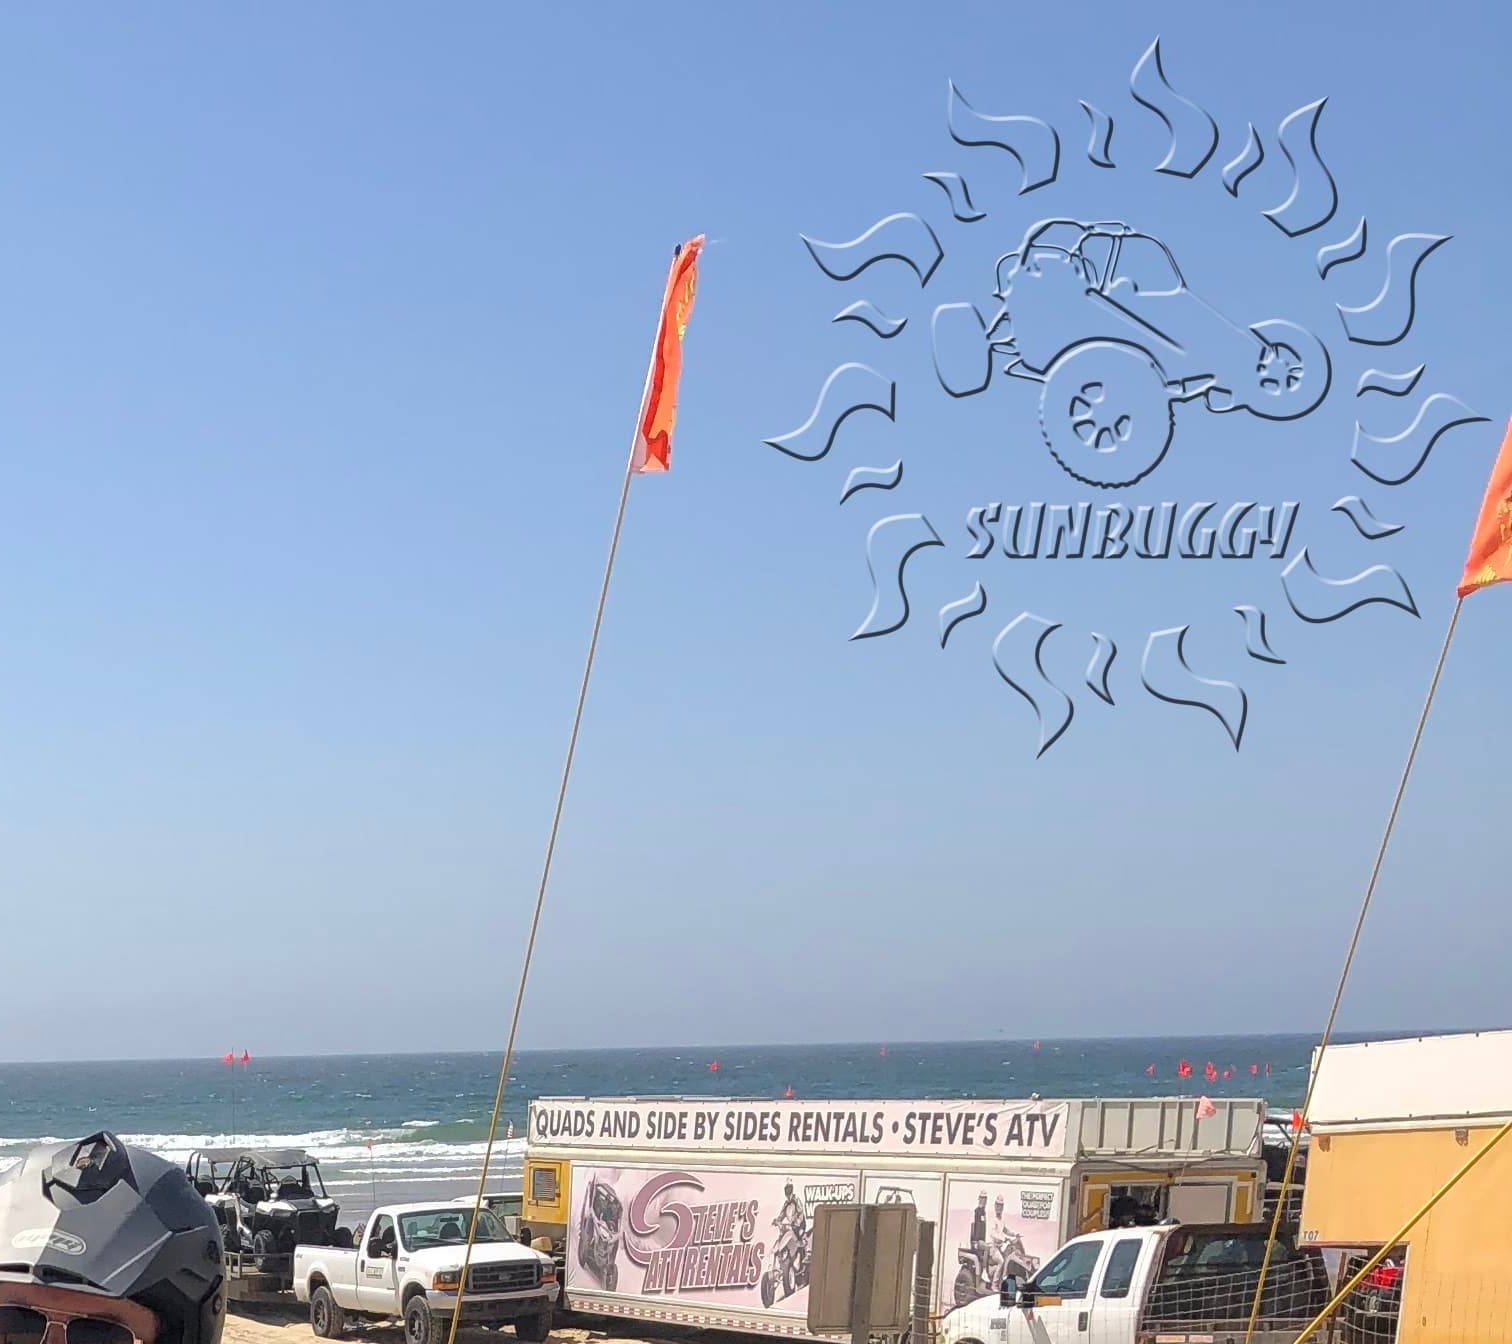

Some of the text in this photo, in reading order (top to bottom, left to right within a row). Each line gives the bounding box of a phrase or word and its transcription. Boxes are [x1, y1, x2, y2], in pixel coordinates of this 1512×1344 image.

[535, 1109, 1061, 1147] QUADS AND SIDE BY SIDES RENTALS STEVE'S ATV
[641, 1241, 767, 1293] ATV RENTALS
